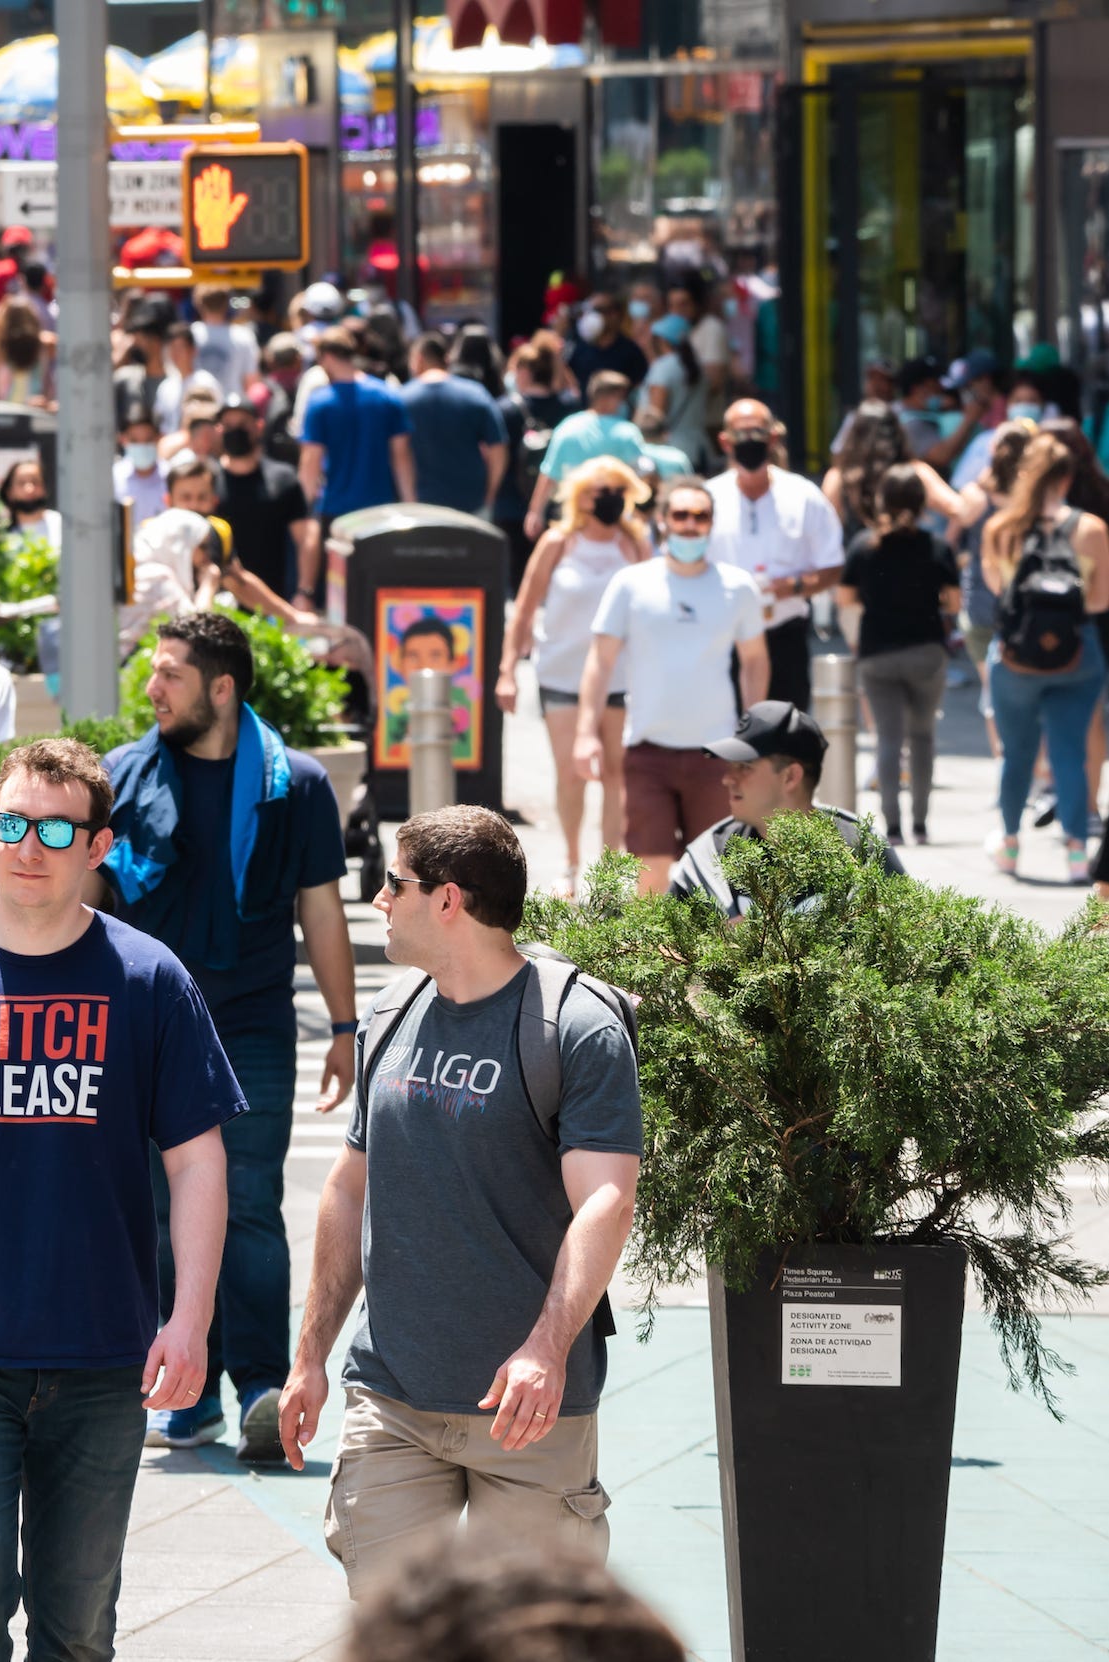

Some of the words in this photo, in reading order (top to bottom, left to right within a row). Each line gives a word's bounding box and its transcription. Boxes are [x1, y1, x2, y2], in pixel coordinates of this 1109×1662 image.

[406, 1047, 502, 1094] LIGO
[806, 1268, 833, 1276] Square
[782, 1276, 820, 1284] Pedestrian
[821, 1276, 842, 1284] Plaza
[804, 1290, 836, 1298] Peatonal
[790, 1312, 842, 1320] DESIGNATED
[828, 1338, 872, 1346] ACTIVIDAD
